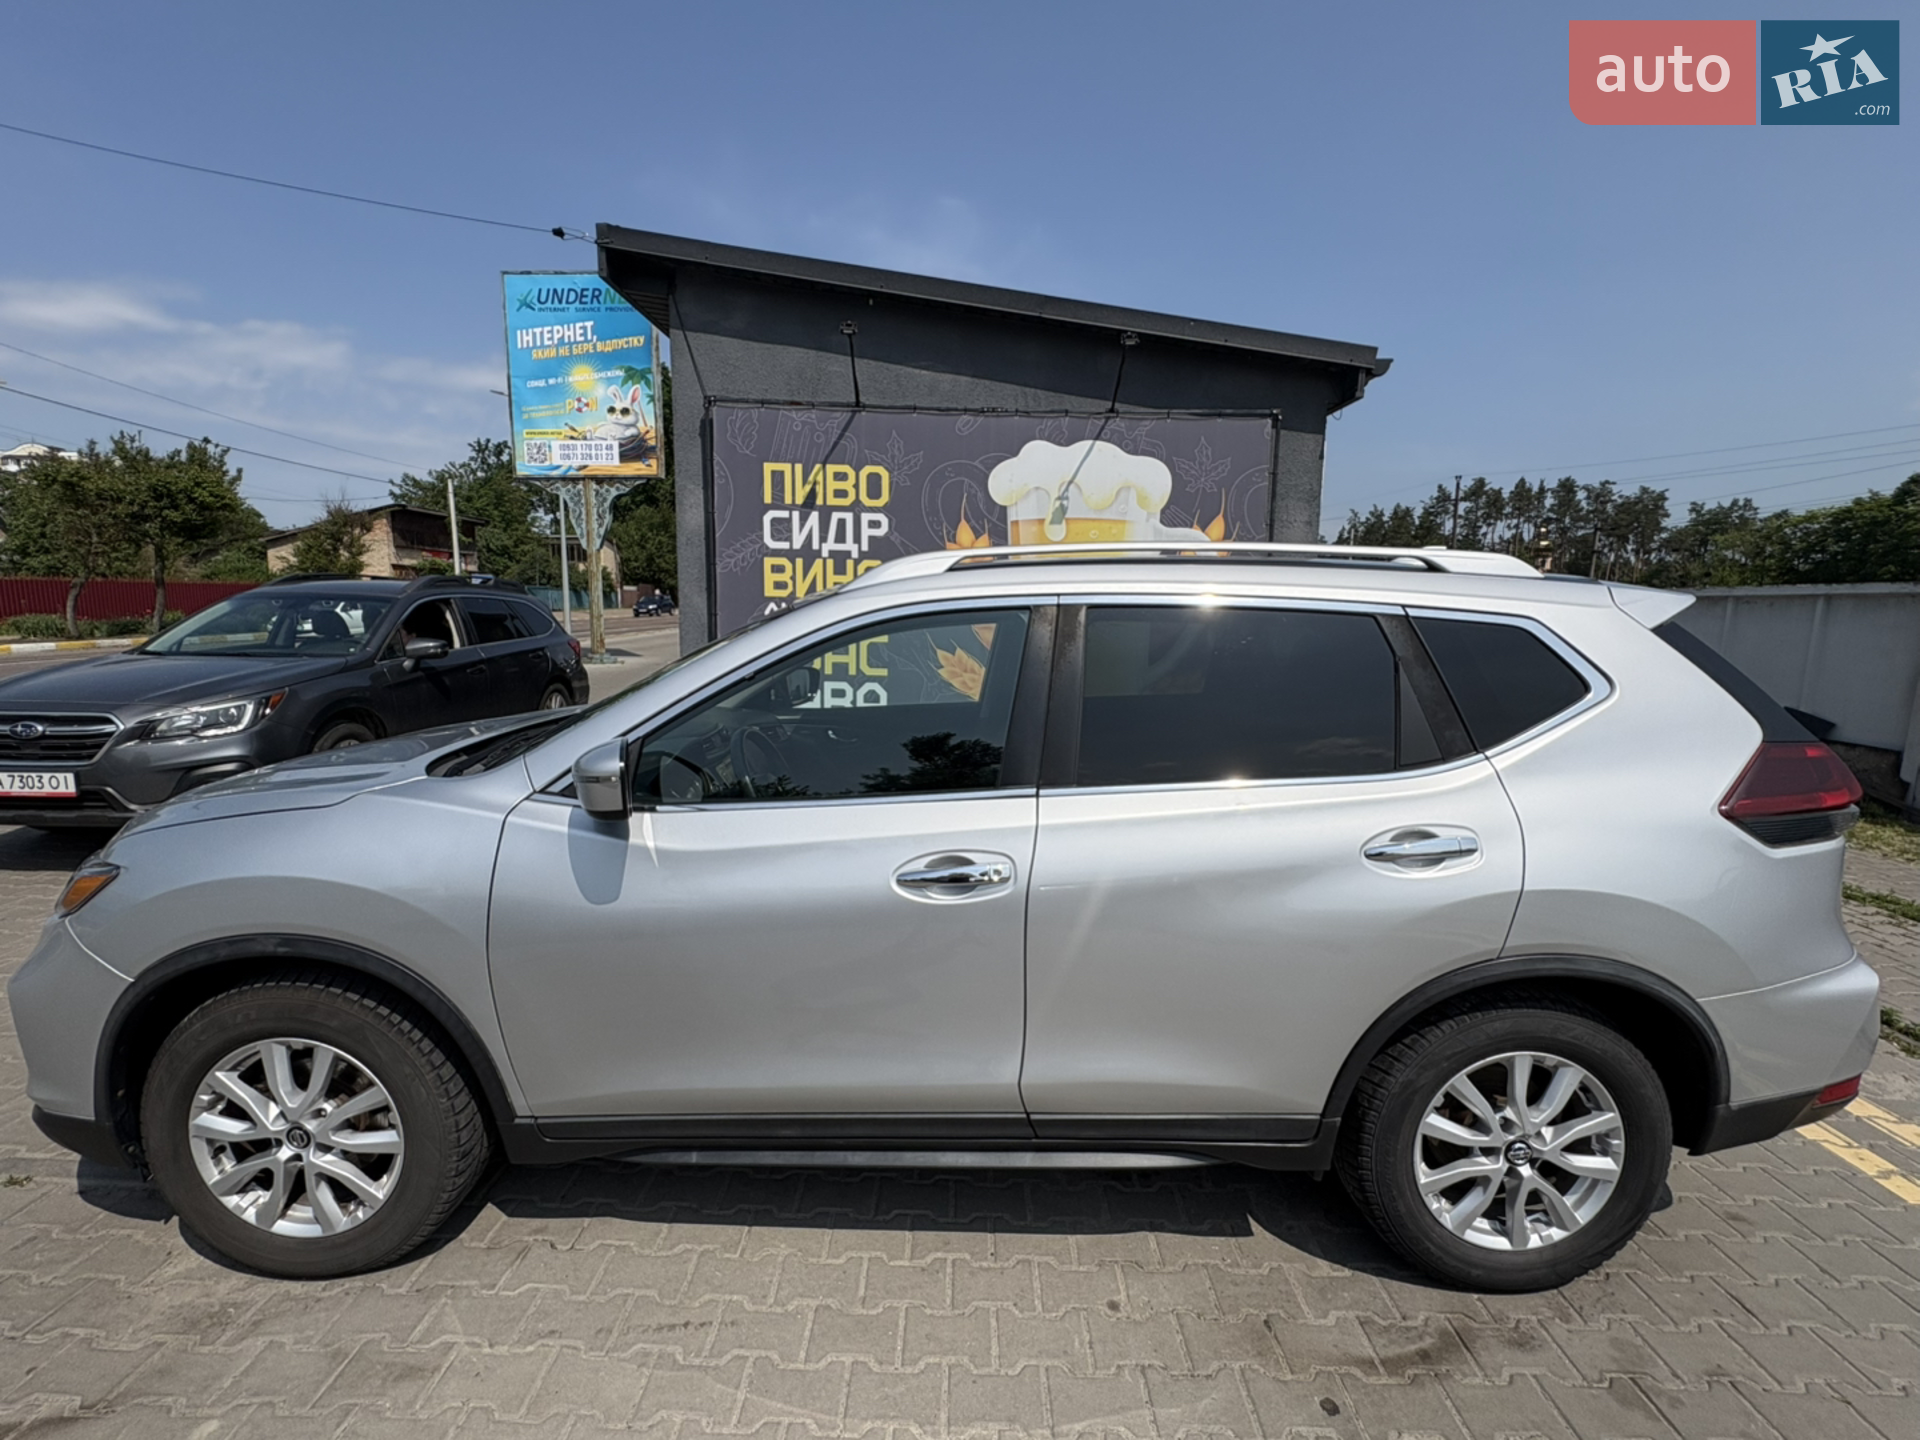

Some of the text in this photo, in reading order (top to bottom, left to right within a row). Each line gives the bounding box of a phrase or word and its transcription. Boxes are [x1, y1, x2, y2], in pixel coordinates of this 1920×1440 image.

[537, 287, 628, 305] UNDERN
[516, 320, 598, 349] ІНТЕРНЕТ,
[531, 335, 646, 361] ЯКИЙ НЕ БЕРЕ ВІДПУСТКУ
[763, 462, 890, 506] ПИВО
[763, 510, 889, 559] СИДР
[7, 774, 45, 790] 7303
